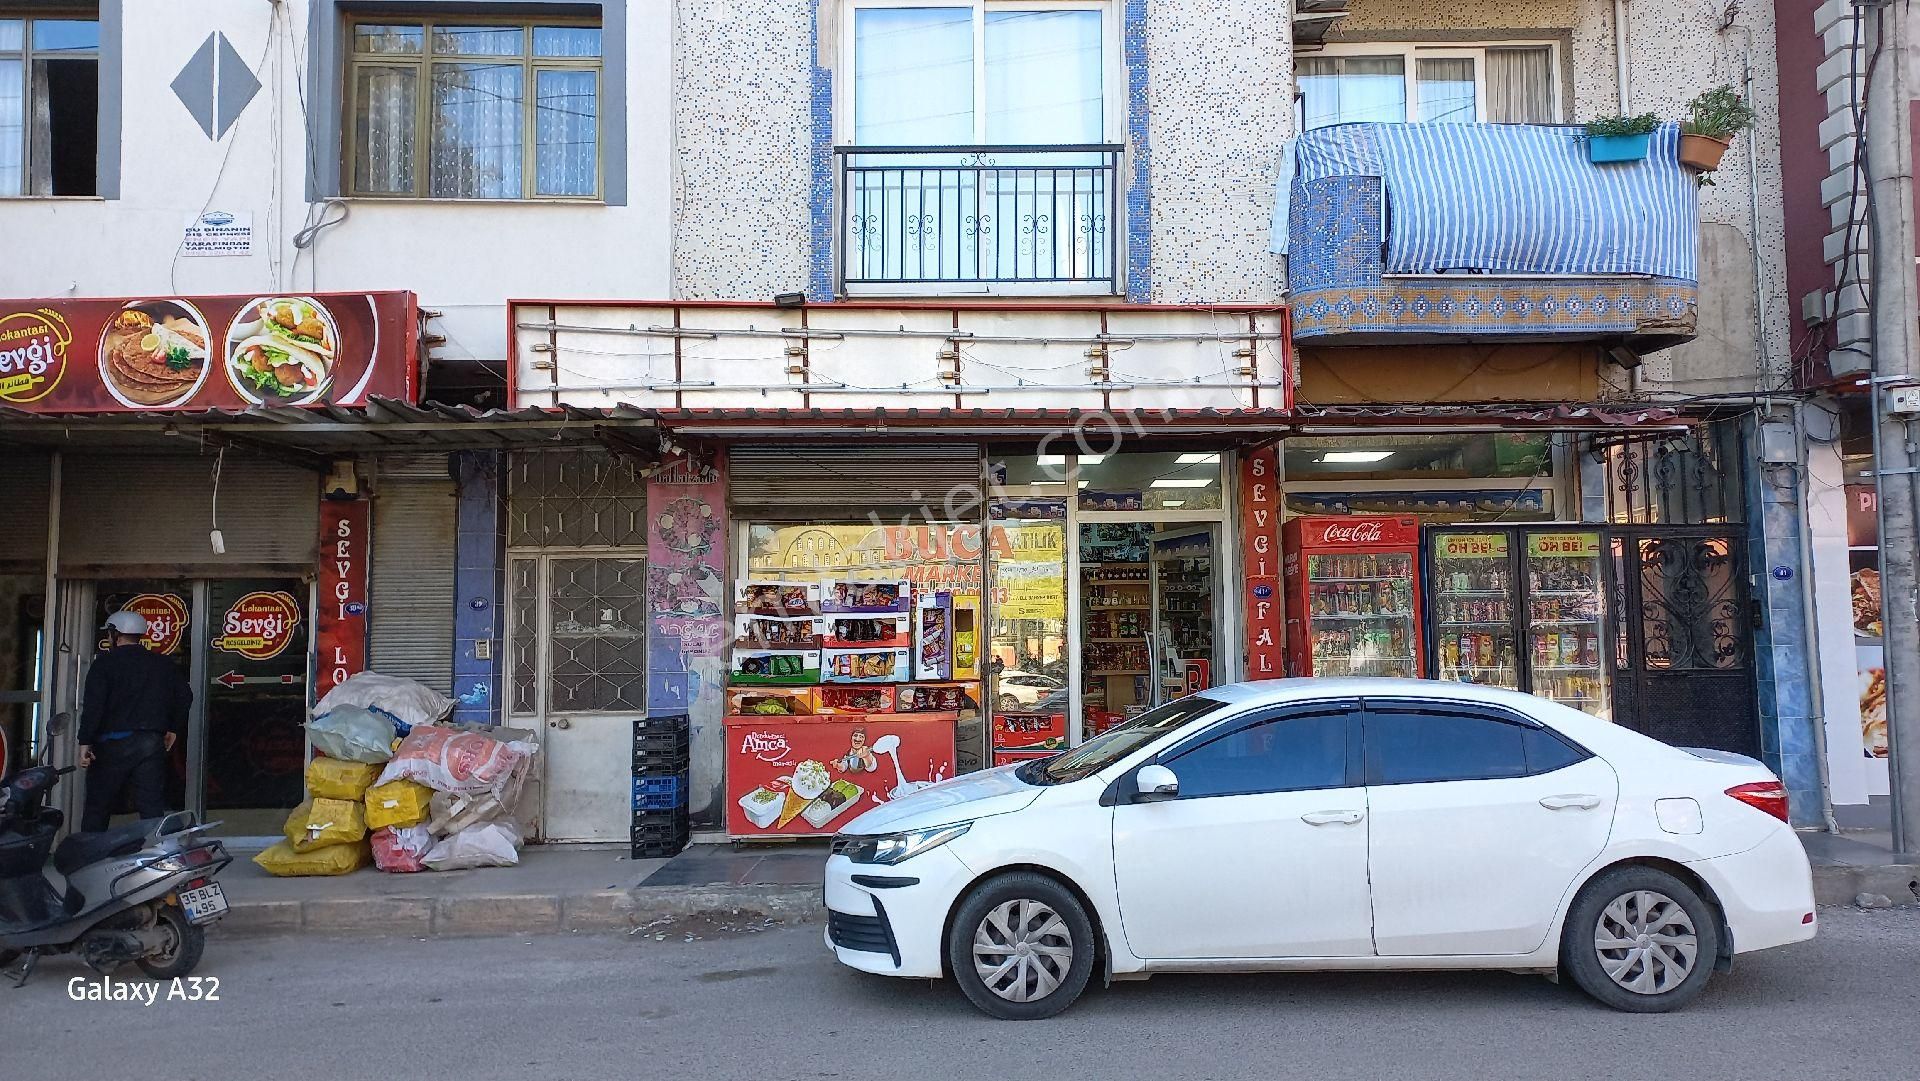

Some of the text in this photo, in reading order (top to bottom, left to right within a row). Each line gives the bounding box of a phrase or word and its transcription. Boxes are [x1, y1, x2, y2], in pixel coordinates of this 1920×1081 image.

[883, 525, 1015, 561] BUCA
[225, 611, 283, 639] Sevgi
[740, 734, 786, 754] Amca
[182, 885, 221, 906] 35 BLZ
[195, 901, 217, 915] 495
